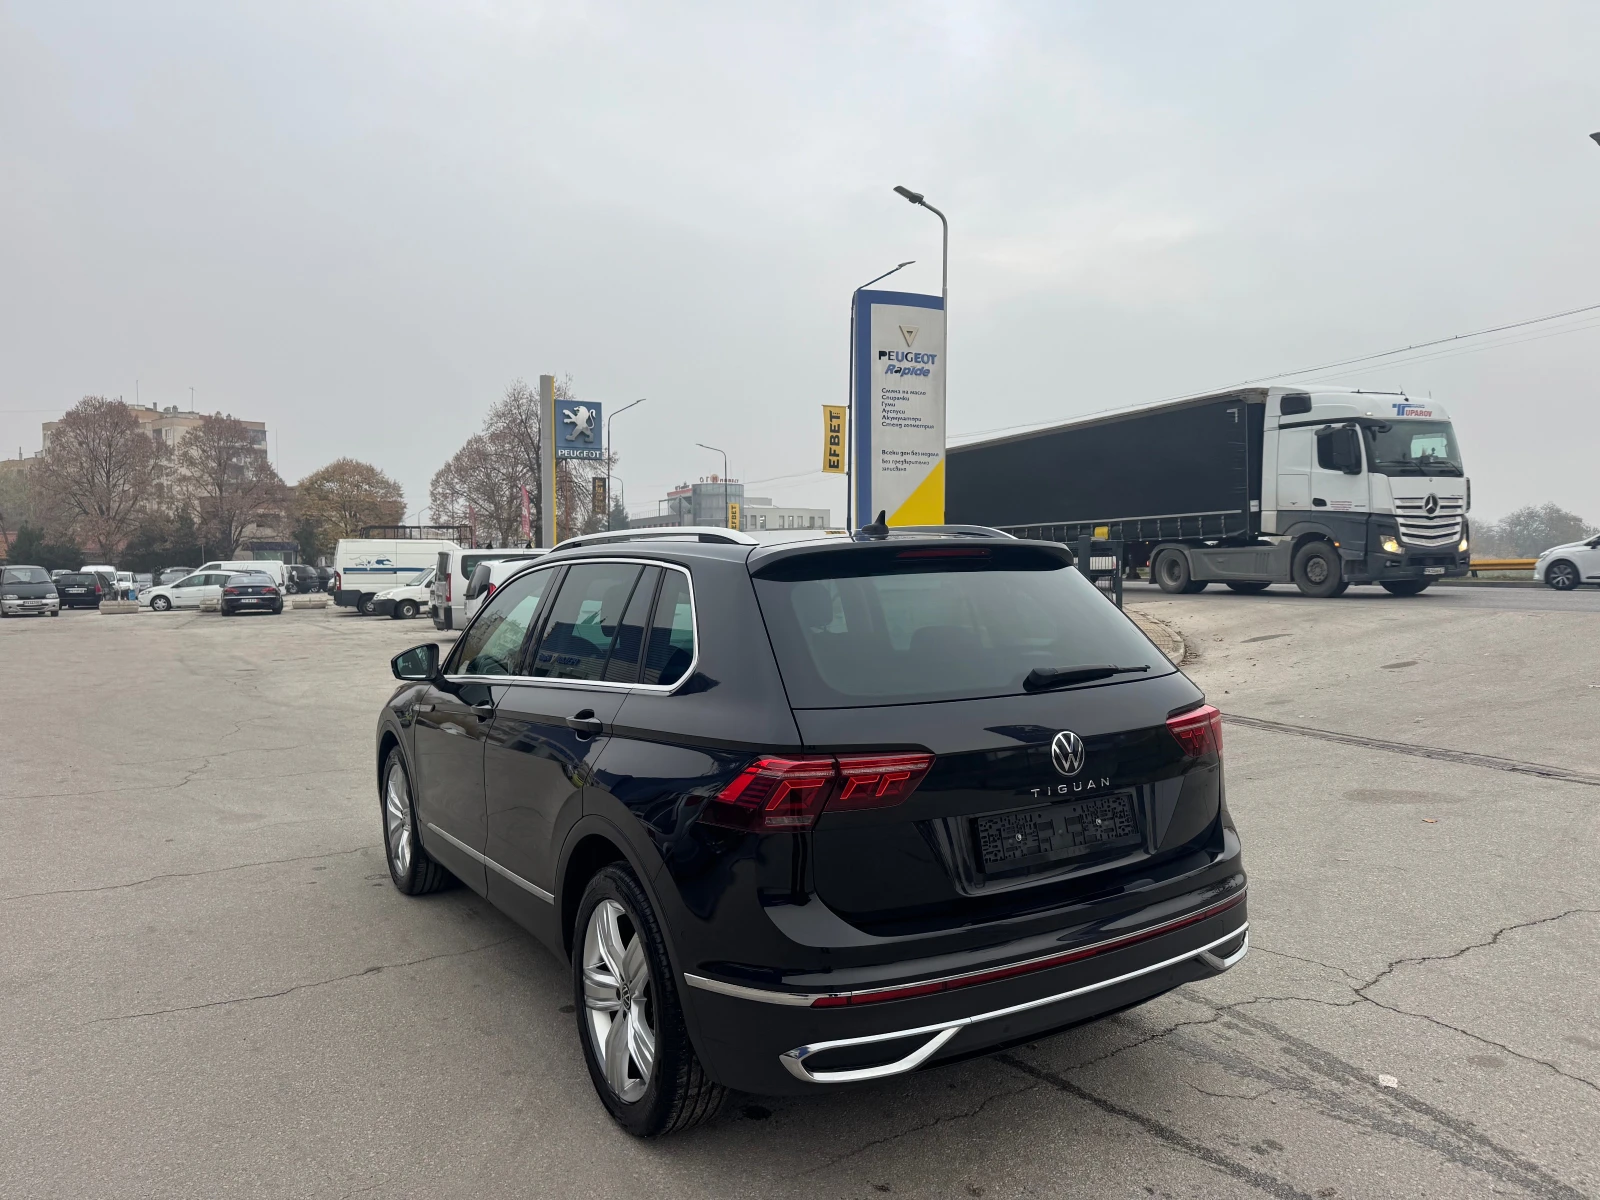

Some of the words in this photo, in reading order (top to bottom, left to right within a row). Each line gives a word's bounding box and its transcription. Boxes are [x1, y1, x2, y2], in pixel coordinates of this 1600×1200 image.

[879, 350, 938, 365] PEUGEOT
[885, 364, 930, 377] Rapide
[828, 410, 841, 469] EFBET
[558, 449, 601, 458] PEUGEOT
[1030, 777, 1110, 798] TIGUAN
